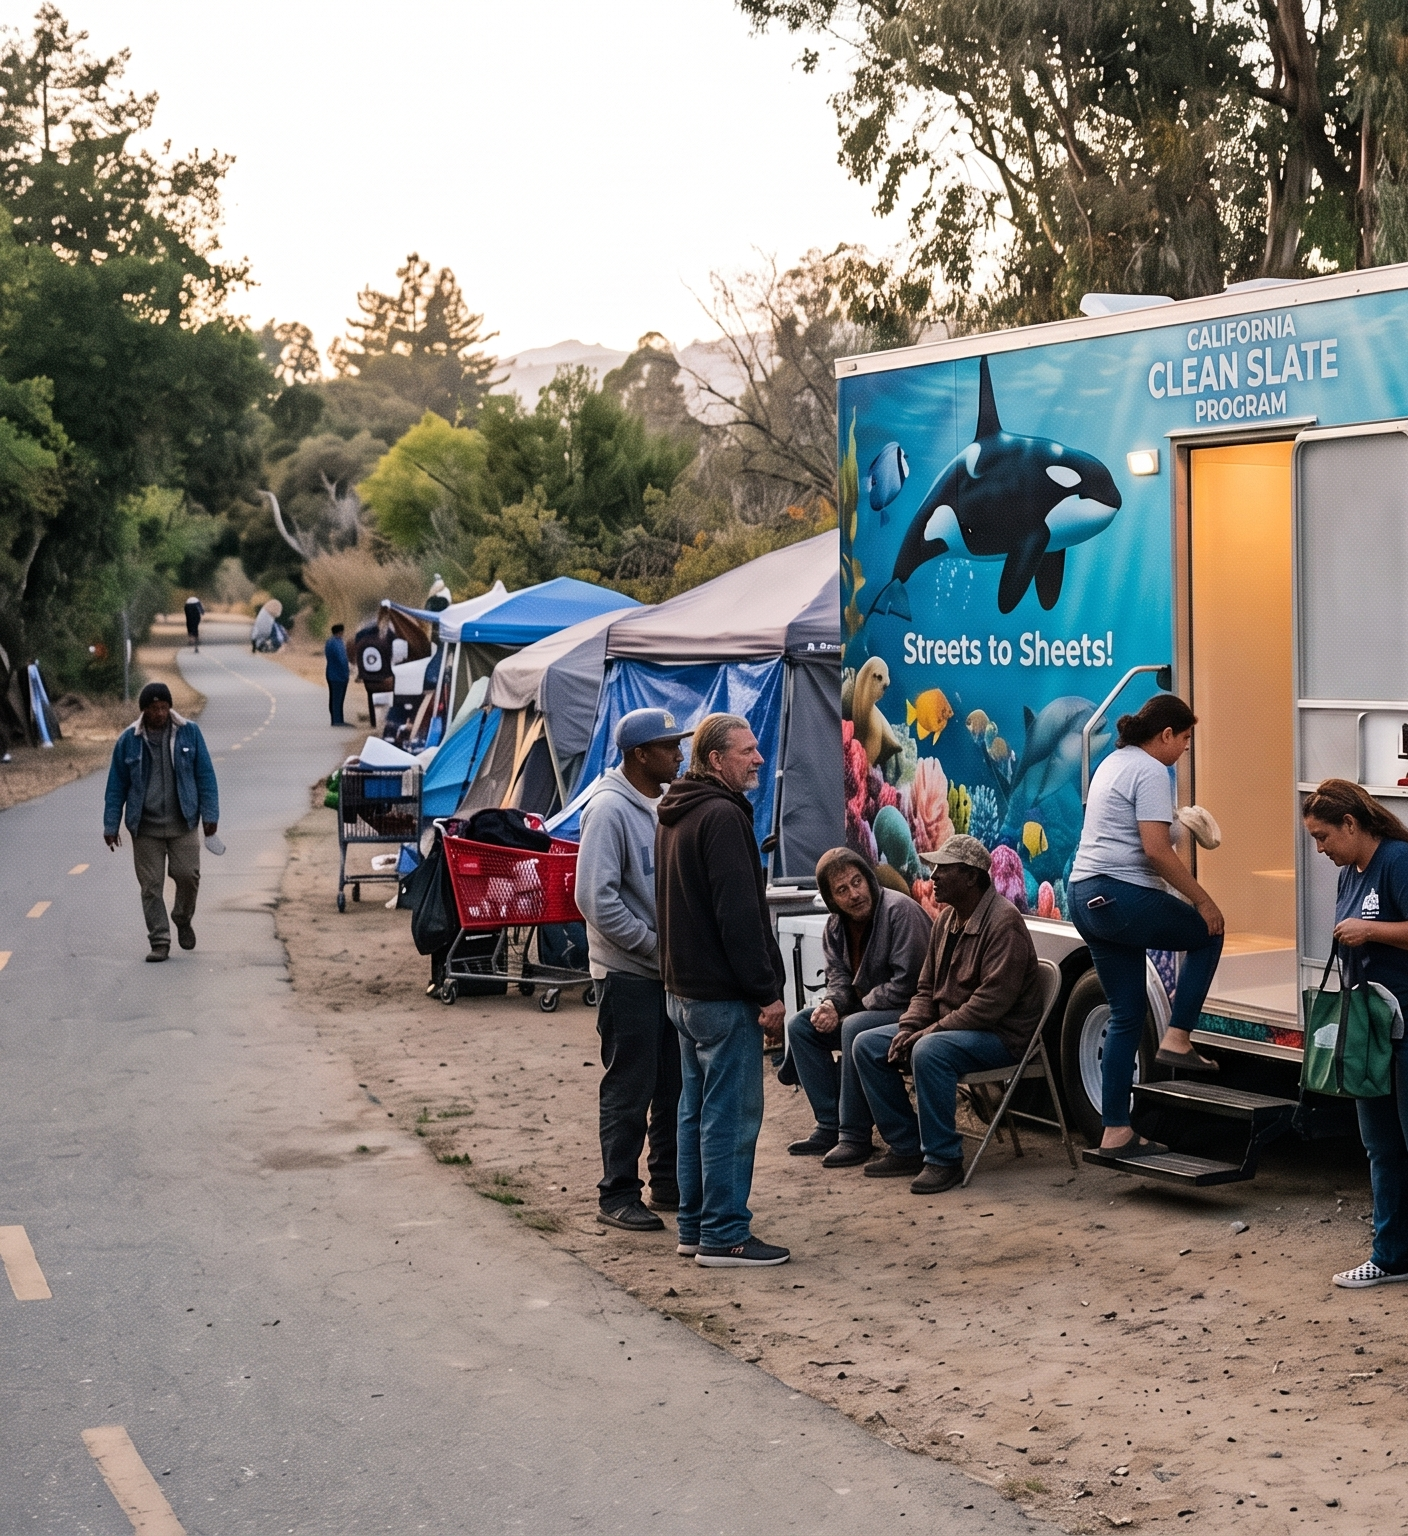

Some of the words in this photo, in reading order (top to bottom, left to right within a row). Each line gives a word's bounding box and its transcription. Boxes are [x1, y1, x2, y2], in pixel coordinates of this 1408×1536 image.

[1188, 314, 1296, 351] CALIFORNIA
[1149, 353, 1239, 399] CLEAN
[1247, 339, 1339, 387] SLATE
[1196, 390, 1287, 422] PROGRAM
[903, 631, 981, 666] Streets
[987, 635, 1013, 666] to
[1019, 630, 1113, 667] Sheets!
